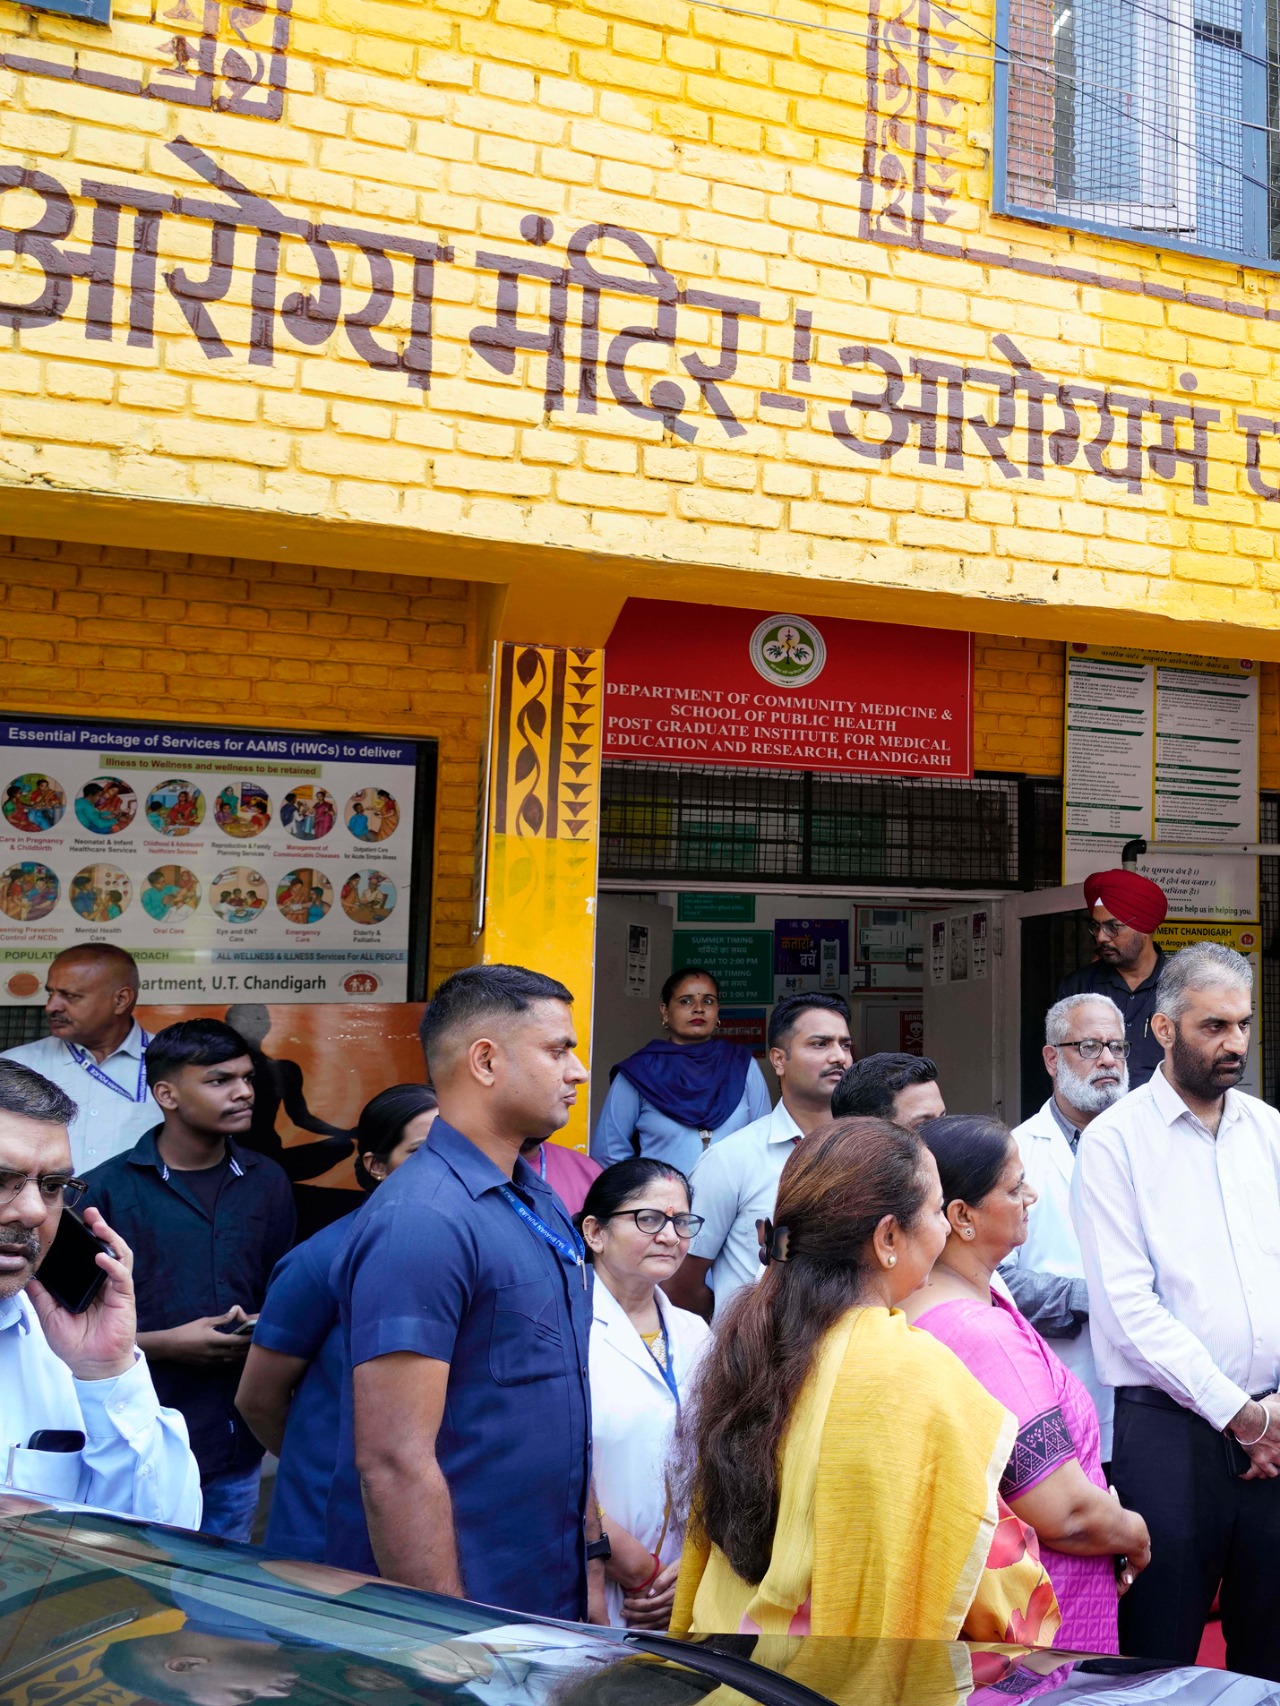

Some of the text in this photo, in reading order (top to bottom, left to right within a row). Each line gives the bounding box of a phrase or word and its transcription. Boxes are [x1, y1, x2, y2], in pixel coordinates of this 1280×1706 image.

[0, 135, 454, 391] आरोग्य
[469, 213, 761, 442] मंदिर
[606, 682, 953, 721] DEPARTMENT OF COMMUNITY MEDICINE &
[670, 704, 897, 732] SCHOOL OF PUBLIC HEALTH
[608, 716, 951, 751] POST GRADUATE INSTITUTE FOR MEDICAL
[8, 727, 402, 759] Essential Package of Services for AAMS (HWCs) to deliver
[606, 732, 952, 766] EDUCATION AND RESEARCH, CHANDIGARH
[106, 758, 317, 775] Illness to Wellness and wellness to be retained
[17, 844, 52, 852] Childbirth
[27, 837, 64, 846] Pregnancy
[74, 838, 105, 846] Neonatal
[1168, 904, 1183, 912] lease
[1184, 905, 1198, 913] help
[1215, 906, 1238, 916] helping
[286, 929, 321, 937] Emergency
[1180, 927, 1231, 936] CHANDIGARH
[781, 935, 811, 949] कतारों
[233, 953, 275, 961] WELLNESS
[276, 953, 282, 961] &
[284, 953, 314, 961] ILLNESS
[316, 953, 345, 961] Services
[799, 950, 817, 967] बचें
[138, 977, 206, 992] artment,
[212, 976, 238, 990] U.T.
[244, 976, 326, 993] Chandigarh
[518, 1207, 558, 1243] BHAVAN PUNJAB
